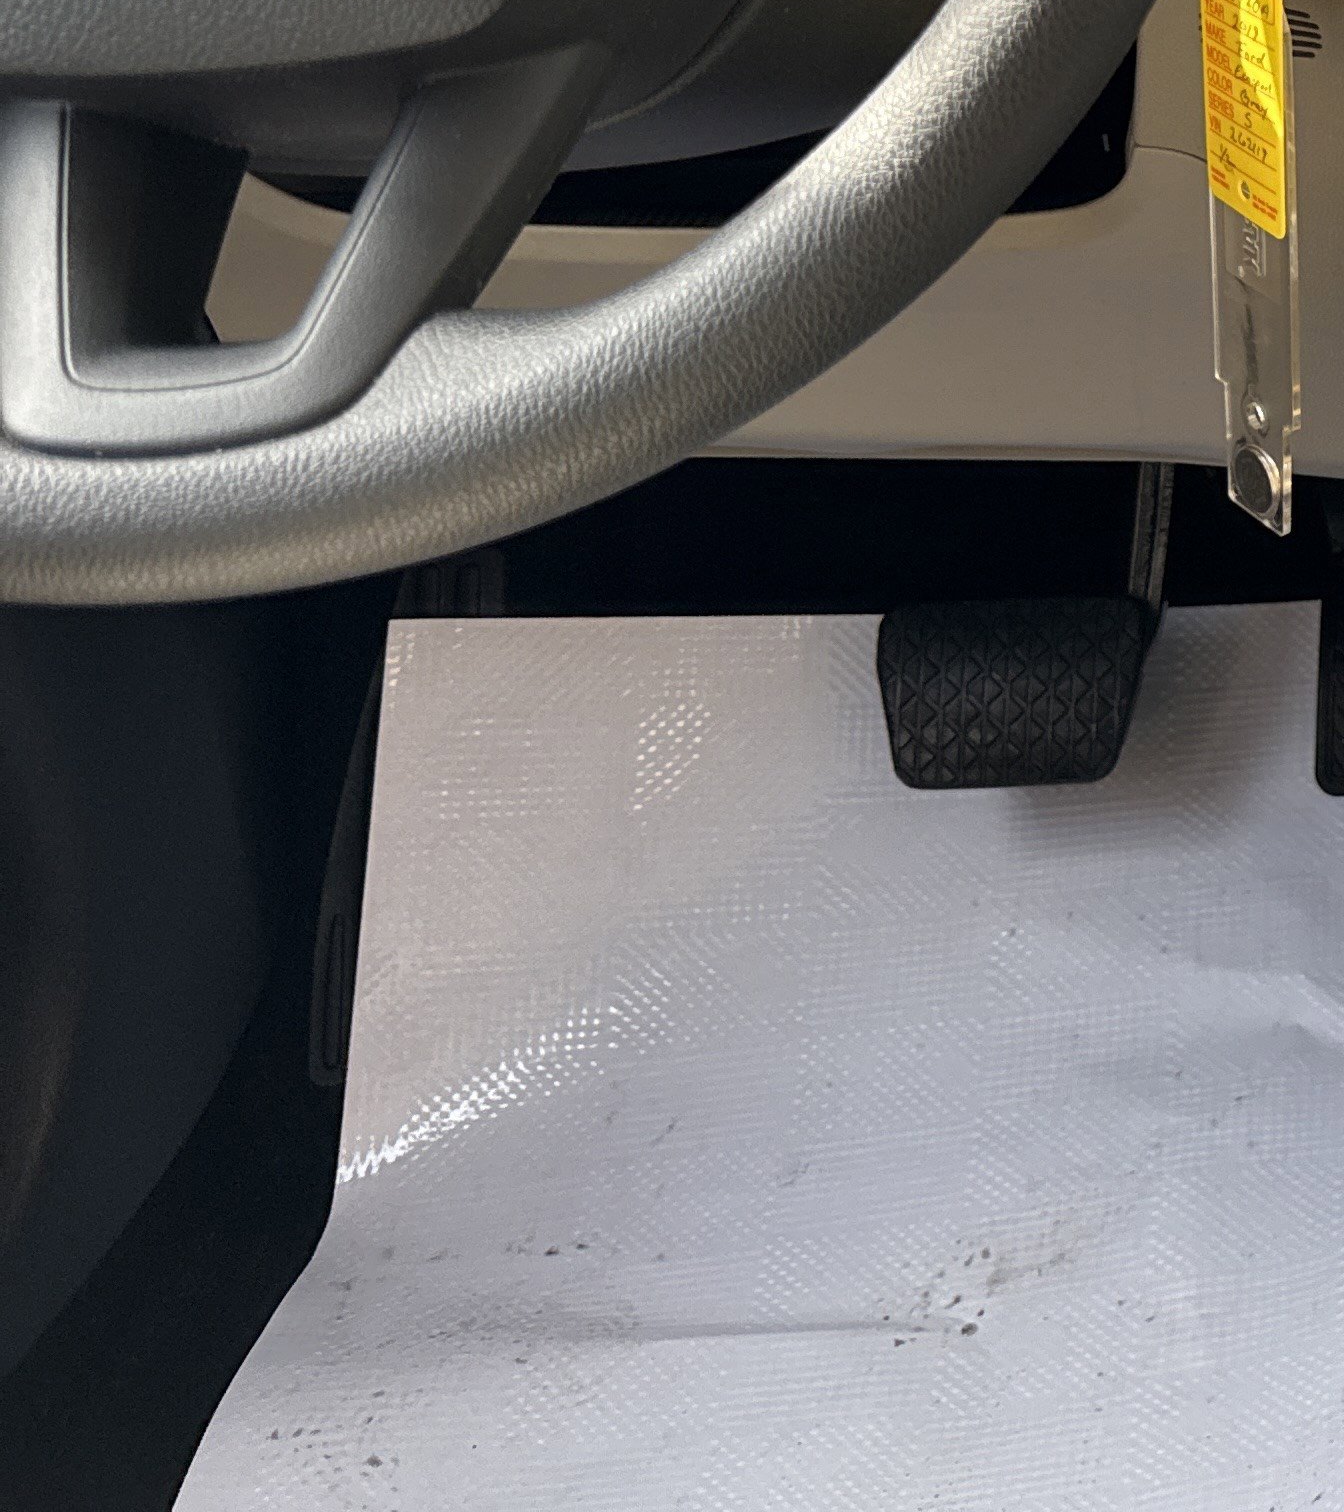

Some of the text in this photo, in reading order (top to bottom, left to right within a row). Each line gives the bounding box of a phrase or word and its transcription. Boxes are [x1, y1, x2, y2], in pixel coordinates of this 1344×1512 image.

[1205, 22, 1227, 45] MAKE
[1206, 45, 1232, 72] MODEL
[1207, 68, 1233, 96] COLOR
[1208, 91, 1235, 120] SERIES
[1210, 116, 1222, 133] VIN
